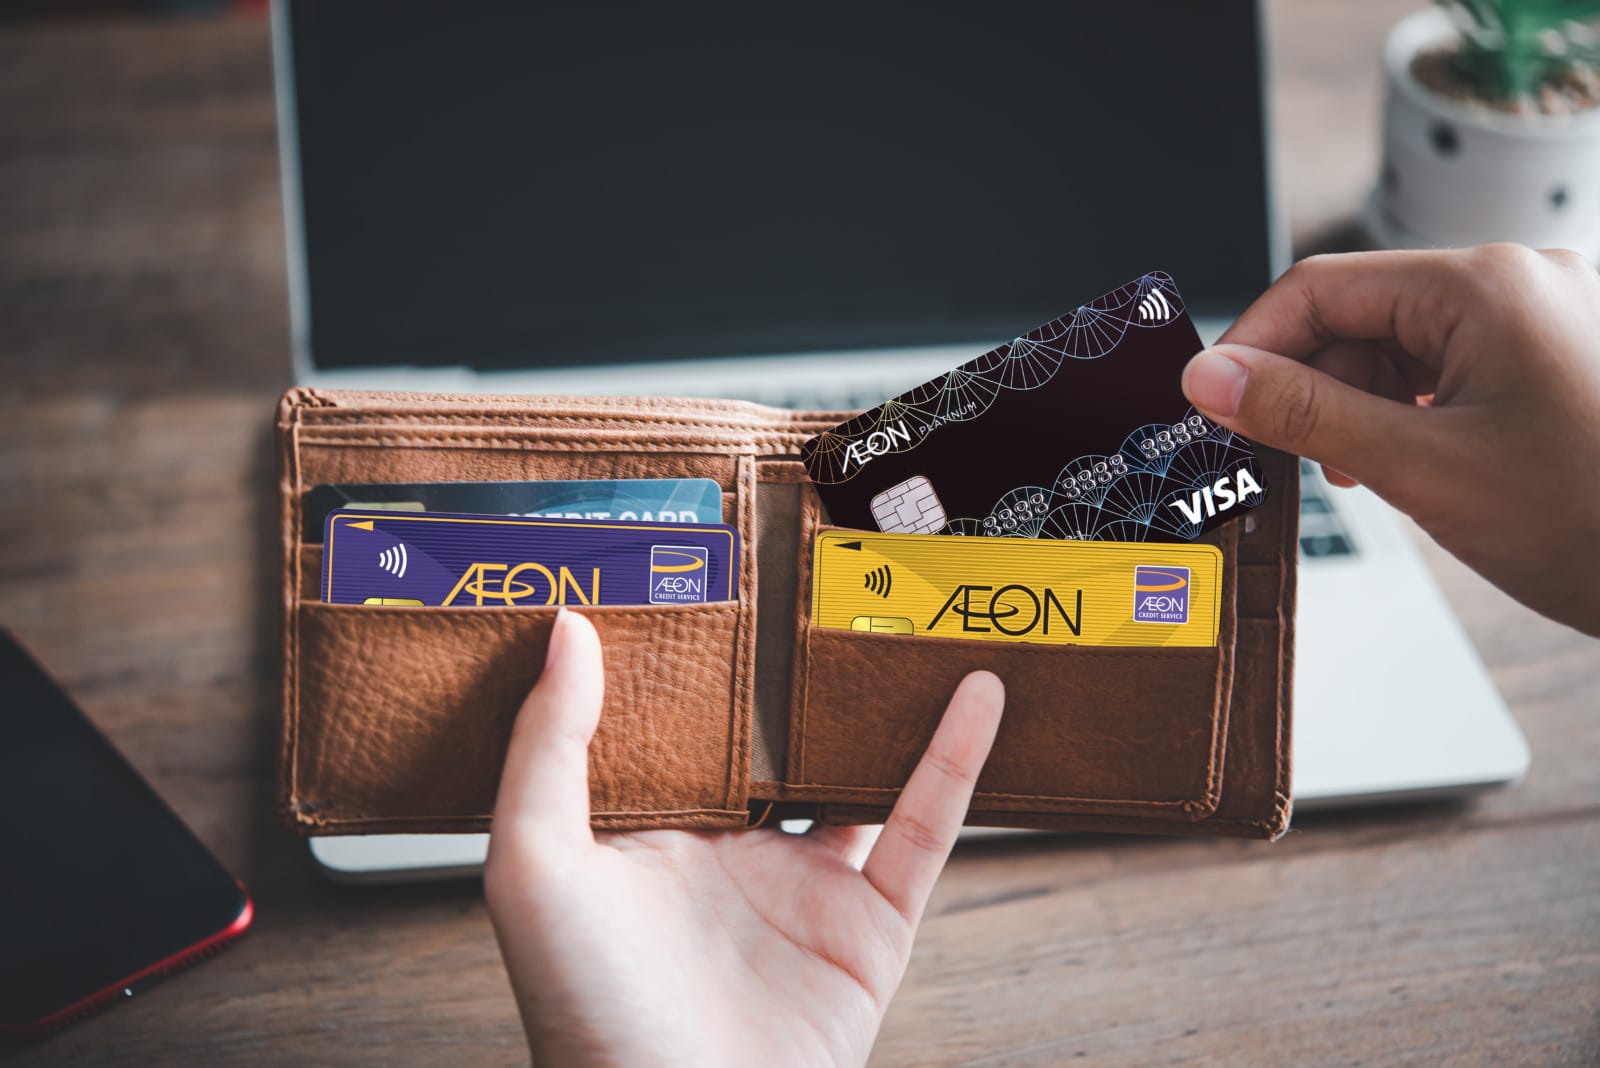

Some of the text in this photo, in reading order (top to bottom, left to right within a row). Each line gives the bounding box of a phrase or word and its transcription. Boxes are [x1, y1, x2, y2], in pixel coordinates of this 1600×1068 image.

[919, 401, 977, 435] PLATINUM
[983, 415, 1207, 537] 8888 8888 8888
[1168, 468, 1263, 525] VISA
